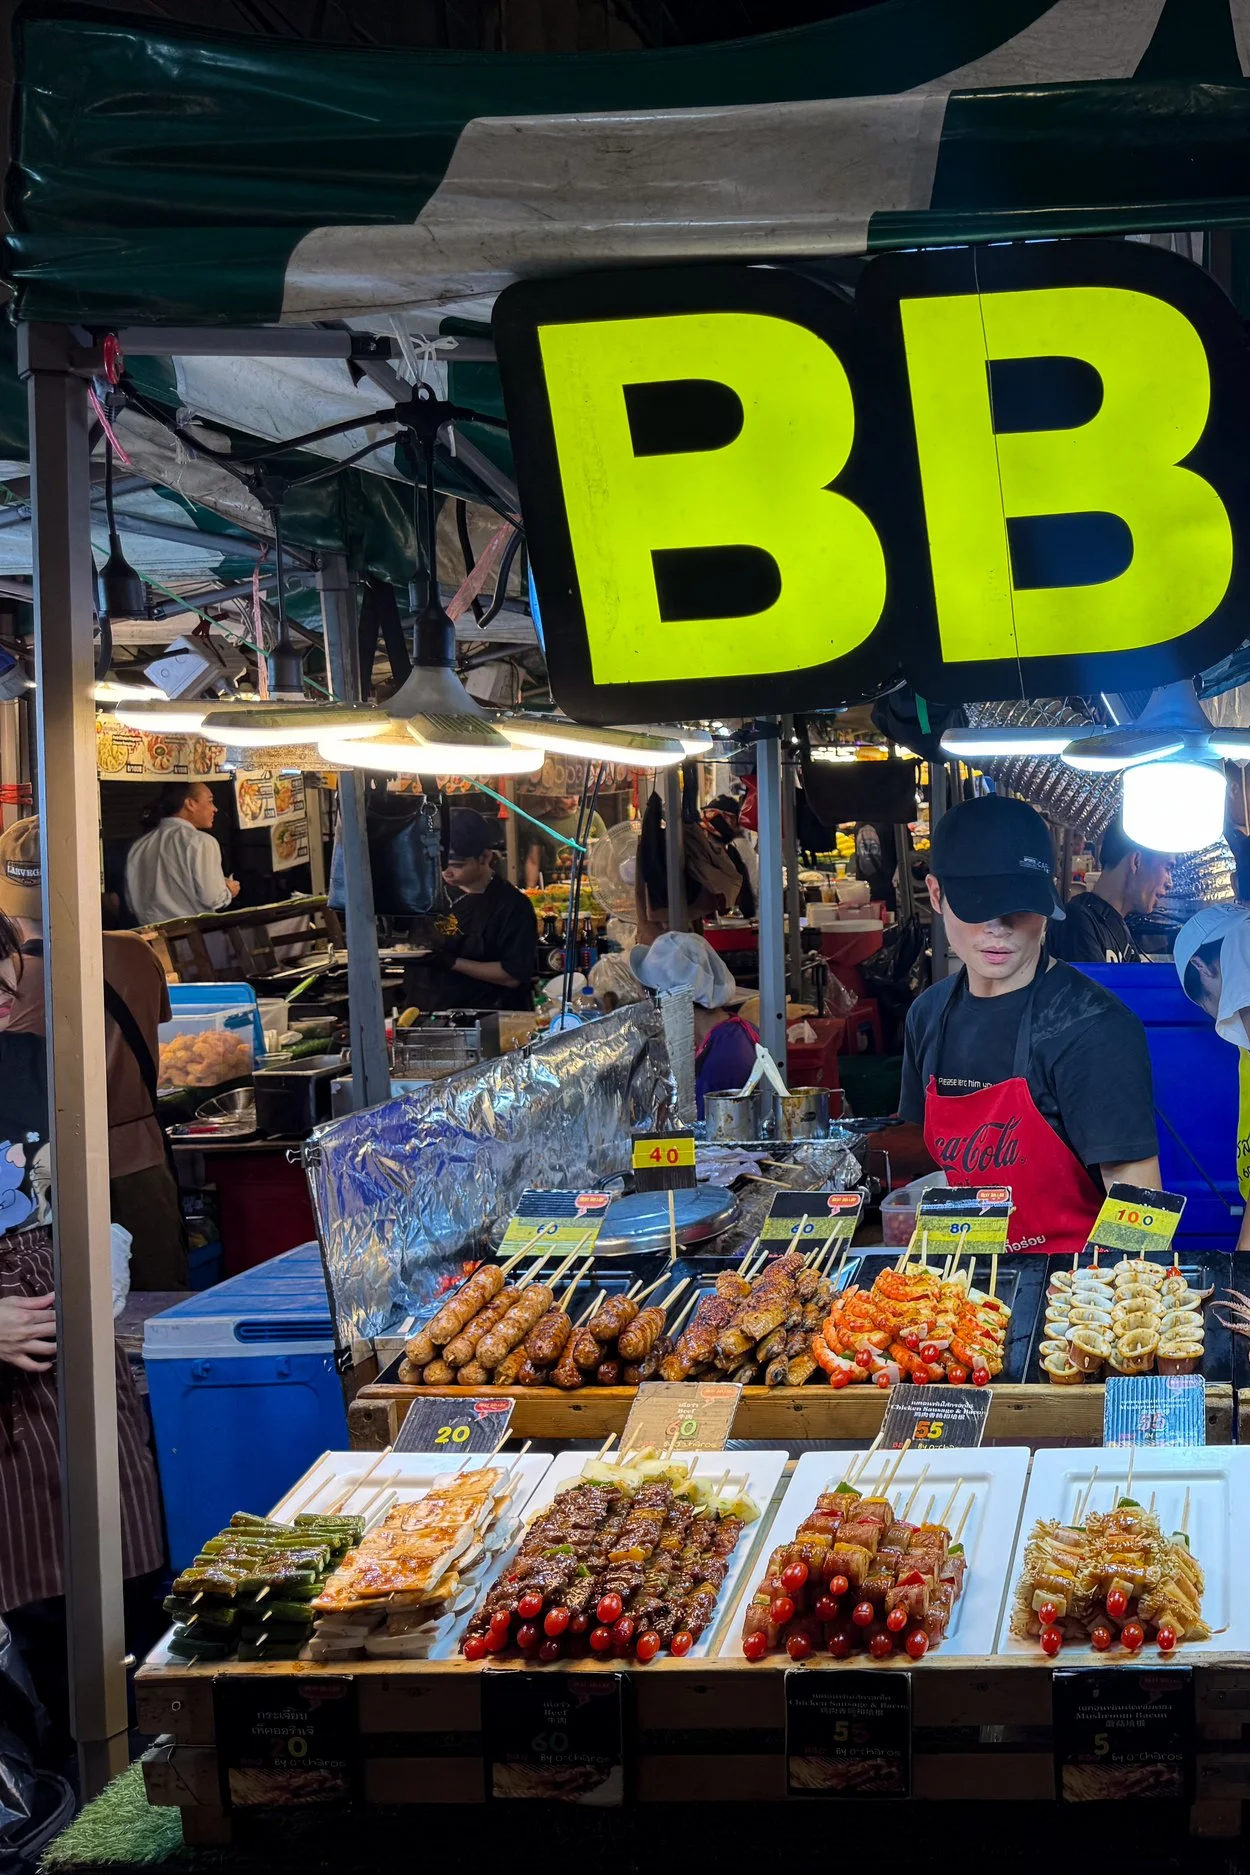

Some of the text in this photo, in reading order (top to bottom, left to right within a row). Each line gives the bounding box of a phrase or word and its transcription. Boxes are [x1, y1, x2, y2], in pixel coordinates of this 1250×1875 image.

[935, 1115, 1023, 1174] ca-Cola
[649, 1147, 680, 1165] 40
[1118, 1209, 1153, 1226] 100
[791, 1223, 815, 1234] 60
[950, 1223, 971, 1234] 80
[923, 1406, 954, 1414] Sausage
[435, 1425, 471, 1443] 20
[665, 1420, 697, 1436] 60
[914, 1421, 944, 1440] 55
[789, 1699, 827, 1708] Chicken
[829, 1700, 869, 1710] Sausage
[1076, 1711, 1168, 1720] Mushroom Bacon
[269, 1736, 308, 1758] 20
[530, 1731, 570, 1753] 60
[835, 1747, 847, 1756] By
